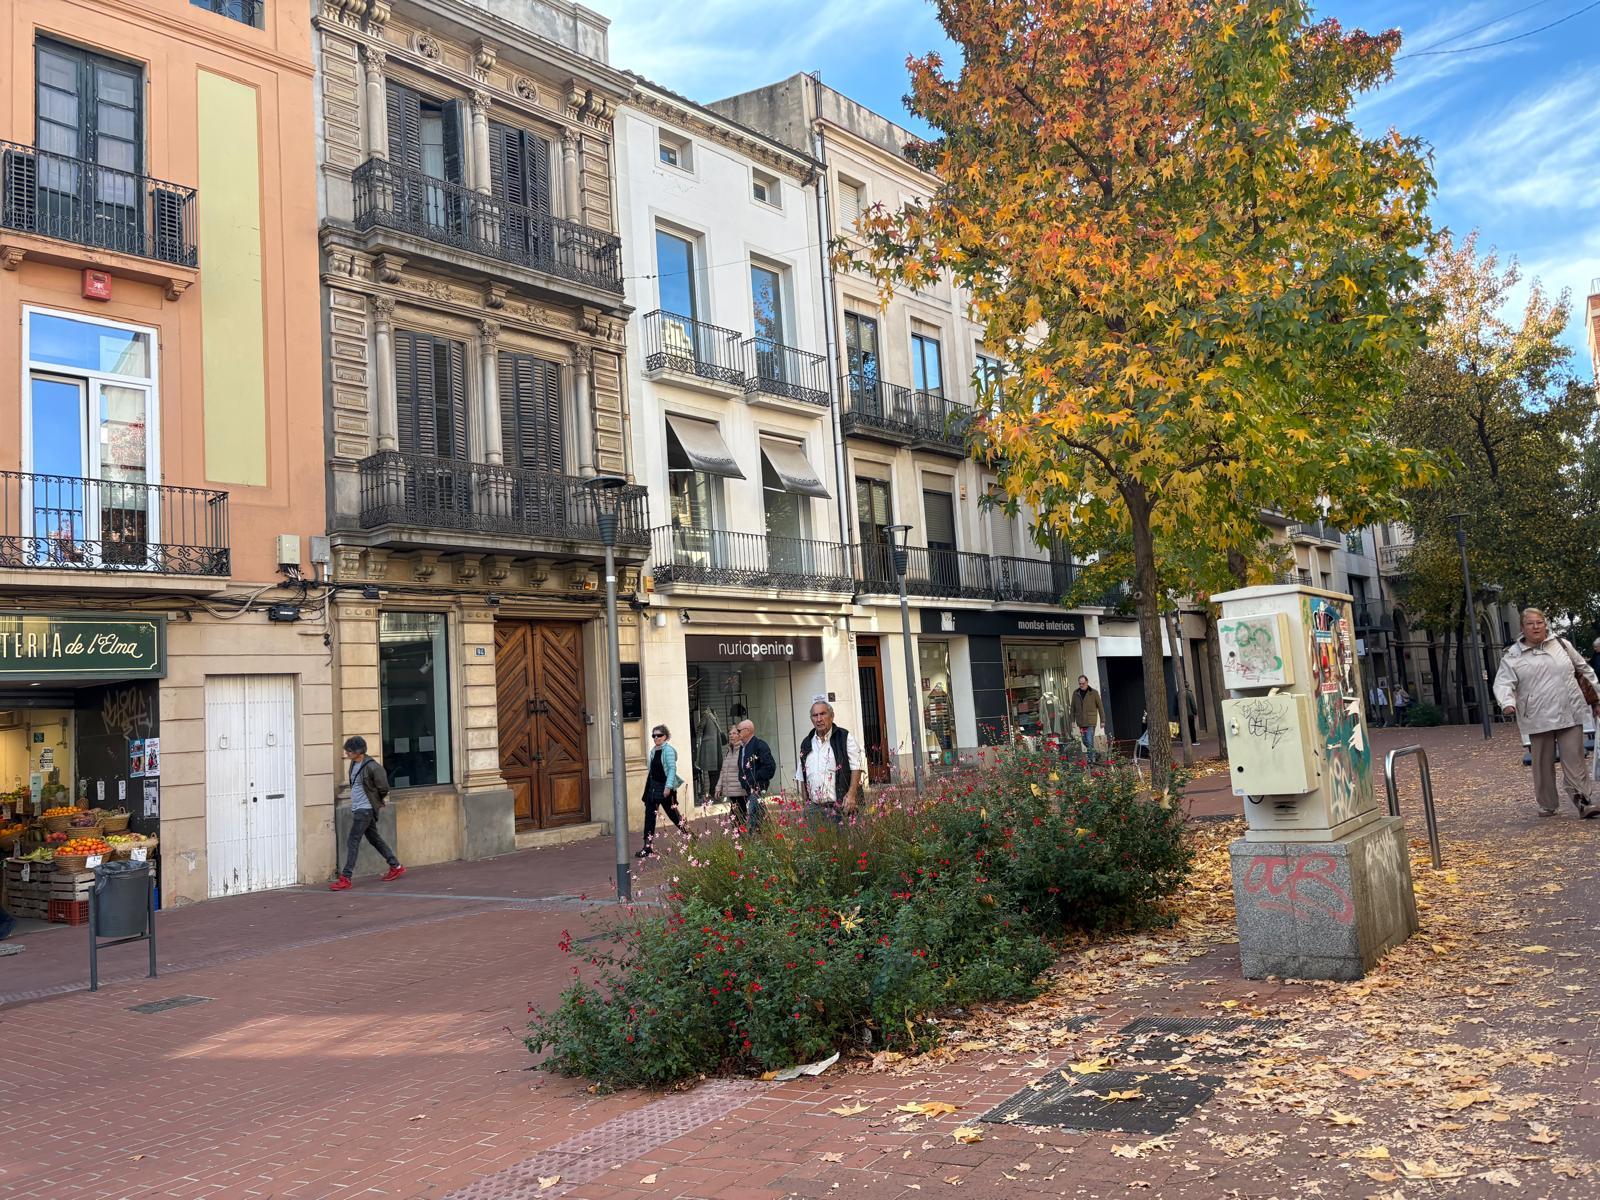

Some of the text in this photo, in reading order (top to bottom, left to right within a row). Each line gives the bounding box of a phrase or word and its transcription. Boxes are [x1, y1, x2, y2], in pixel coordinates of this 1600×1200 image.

[1018, 620, 1075, 631] montse interiors
[0, 632, 62, 658] TERIA
[65, 633, 85, 655] de
[718, 640, 794, 658] nuriapenina
